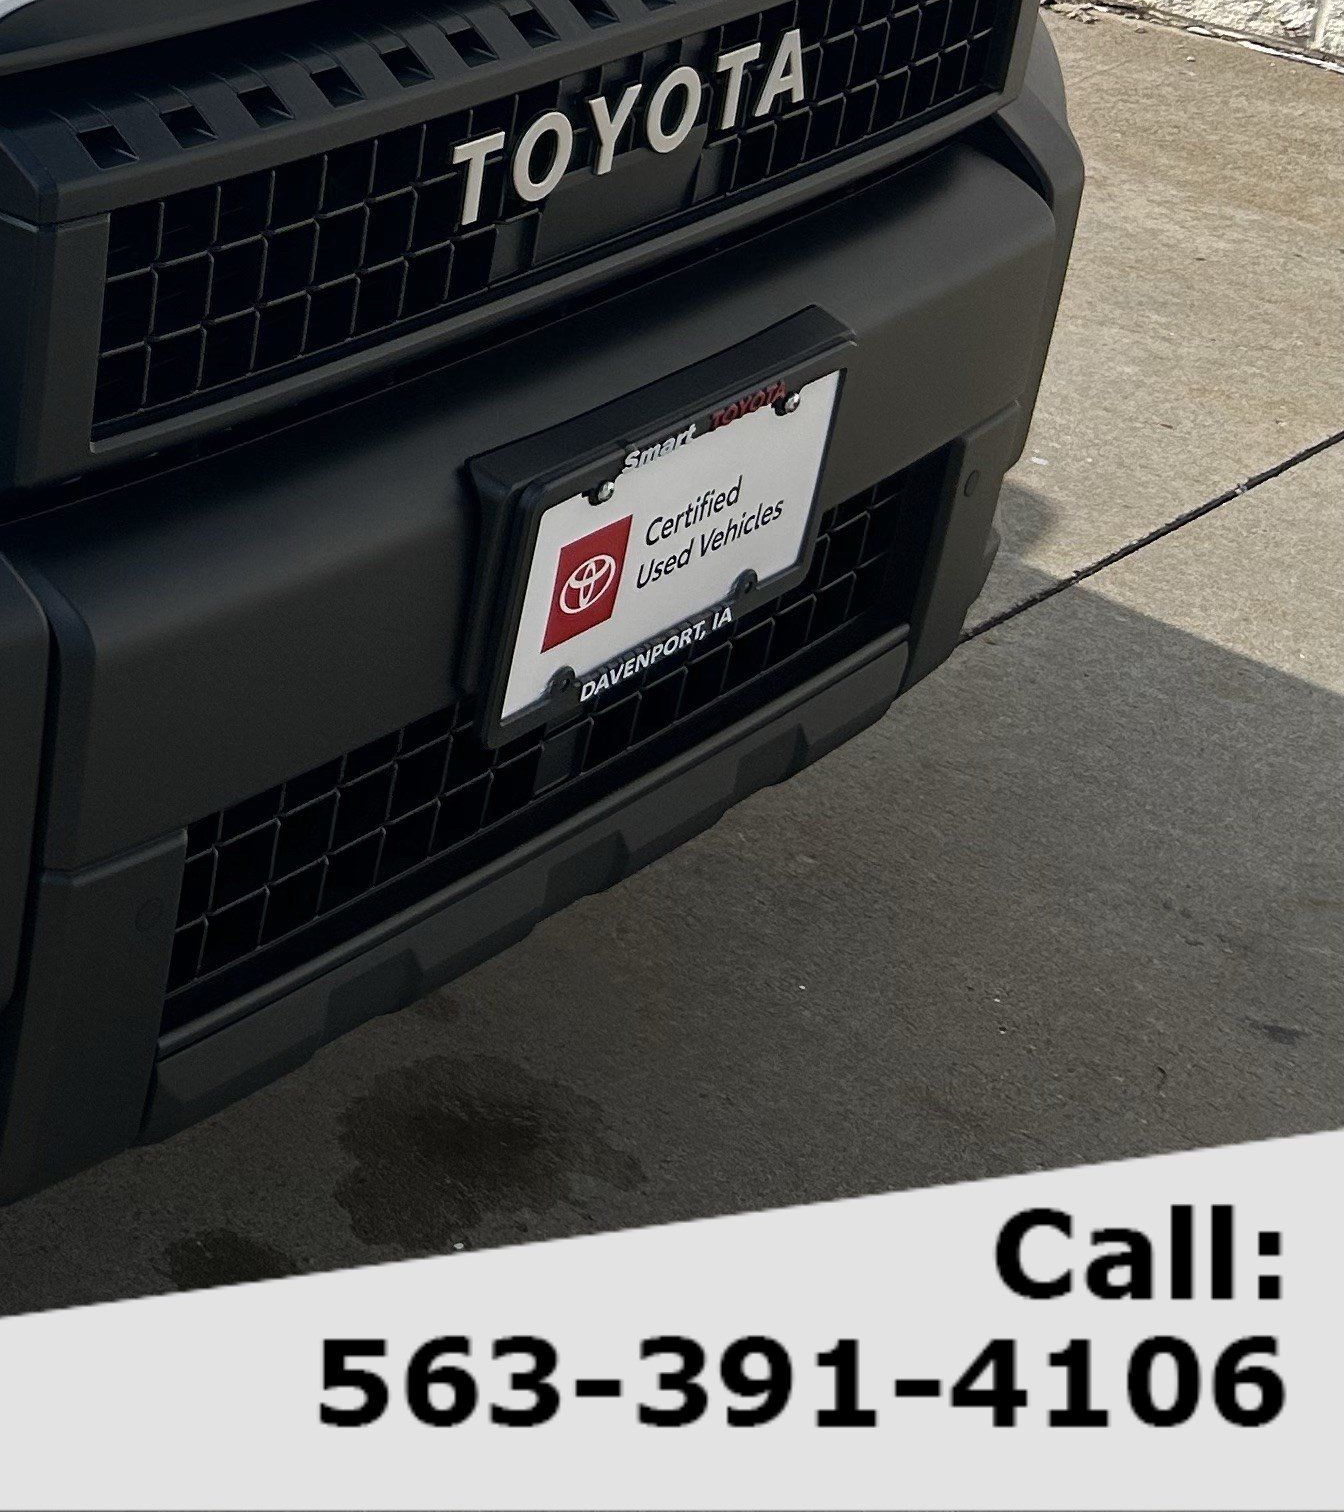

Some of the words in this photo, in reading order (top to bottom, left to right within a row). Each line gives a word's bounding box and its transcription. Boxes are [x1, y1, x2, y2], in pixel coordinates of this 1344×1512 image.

[452, 28, 805, 226] TOYOTA
[622, 423, 697, 473] Smart
[709, 379, 786, 431] TOYOTA
[636, 537, 695, 589] Used
[700, 499, 785, 558] Vehicles
[645, 474, 743, 546] Certified
[579, 620, 708, 703] DAVENPORT,
[712, 606, 734, 632] IA
